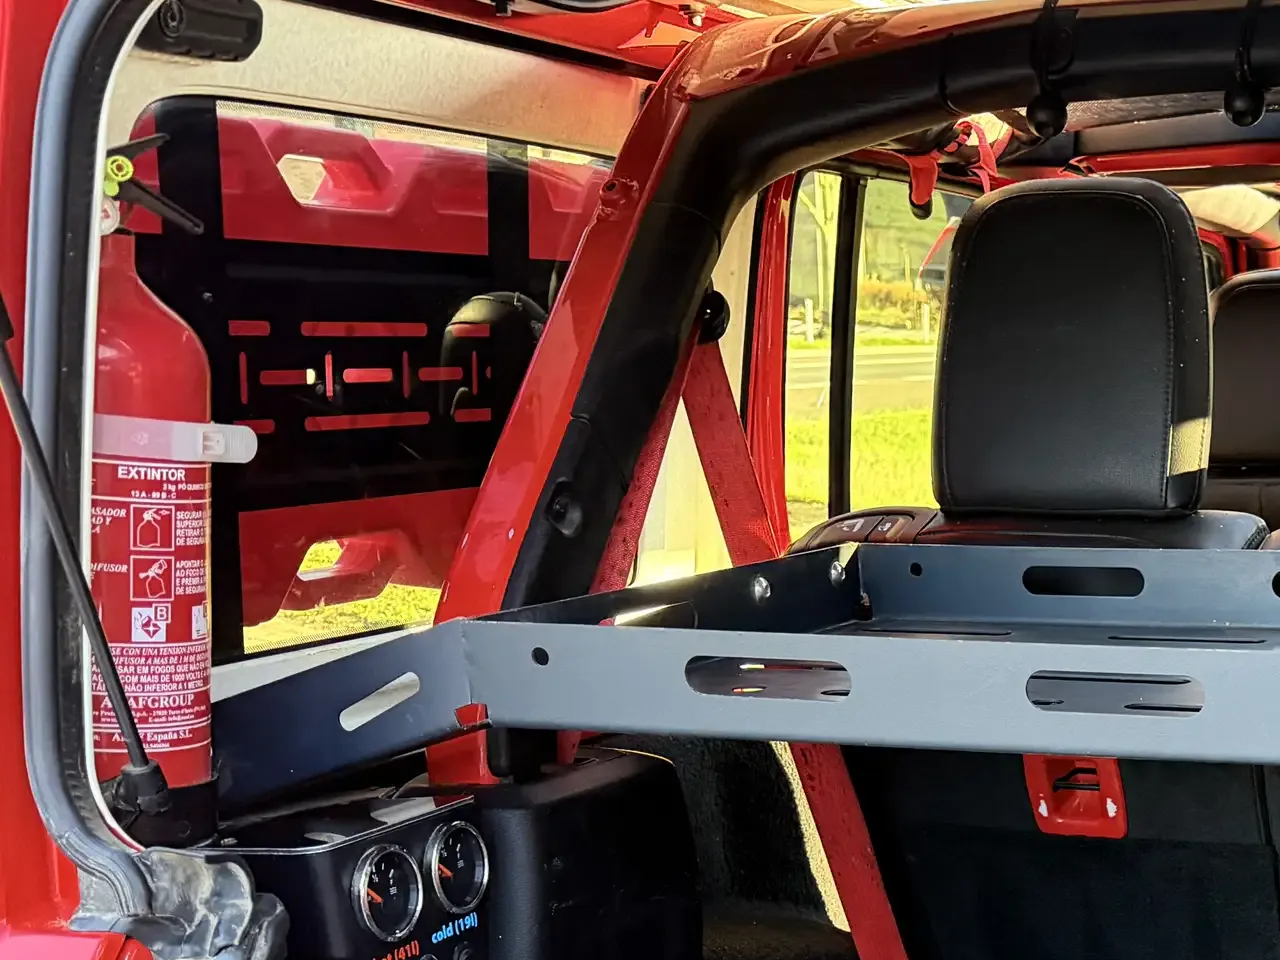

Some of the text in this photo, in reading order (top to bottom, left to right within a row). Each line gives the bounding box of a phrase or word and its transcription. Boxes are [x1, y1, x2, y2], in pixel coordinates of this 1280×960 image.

[117, 465, 186, 481] EXTINTOR
[176, 537, 186, 546] DE
[175, 568, 186, 578] AO
[175, 577, 181, 587] E
[175, 586, 185, 596] DE
[157, 606, 167, 620] B
[122, 647, 141, 656] CON
[142, 647, 158, 656] UNA
[145, 656, 152, 665] A
[153, 655, 168, 665] MAS
[169, 655, 178, 664] DE
[136, 665, 149, 674] EM
[150, 664, 175, 674] FOGOS
[176, 663, 189, 673] QUE
[120, 674, 139, 683] COM
[140, 674, 159, 683] MAIS
[160, 674, 170, 683] DE
[124, 681, 143, 692] NÃO
[144, 682, 177, 692] INFERIOR
[177, 682, 184, 691] A
[147, 731, 178, 743] España
[431, 922, 454, 944] cold
